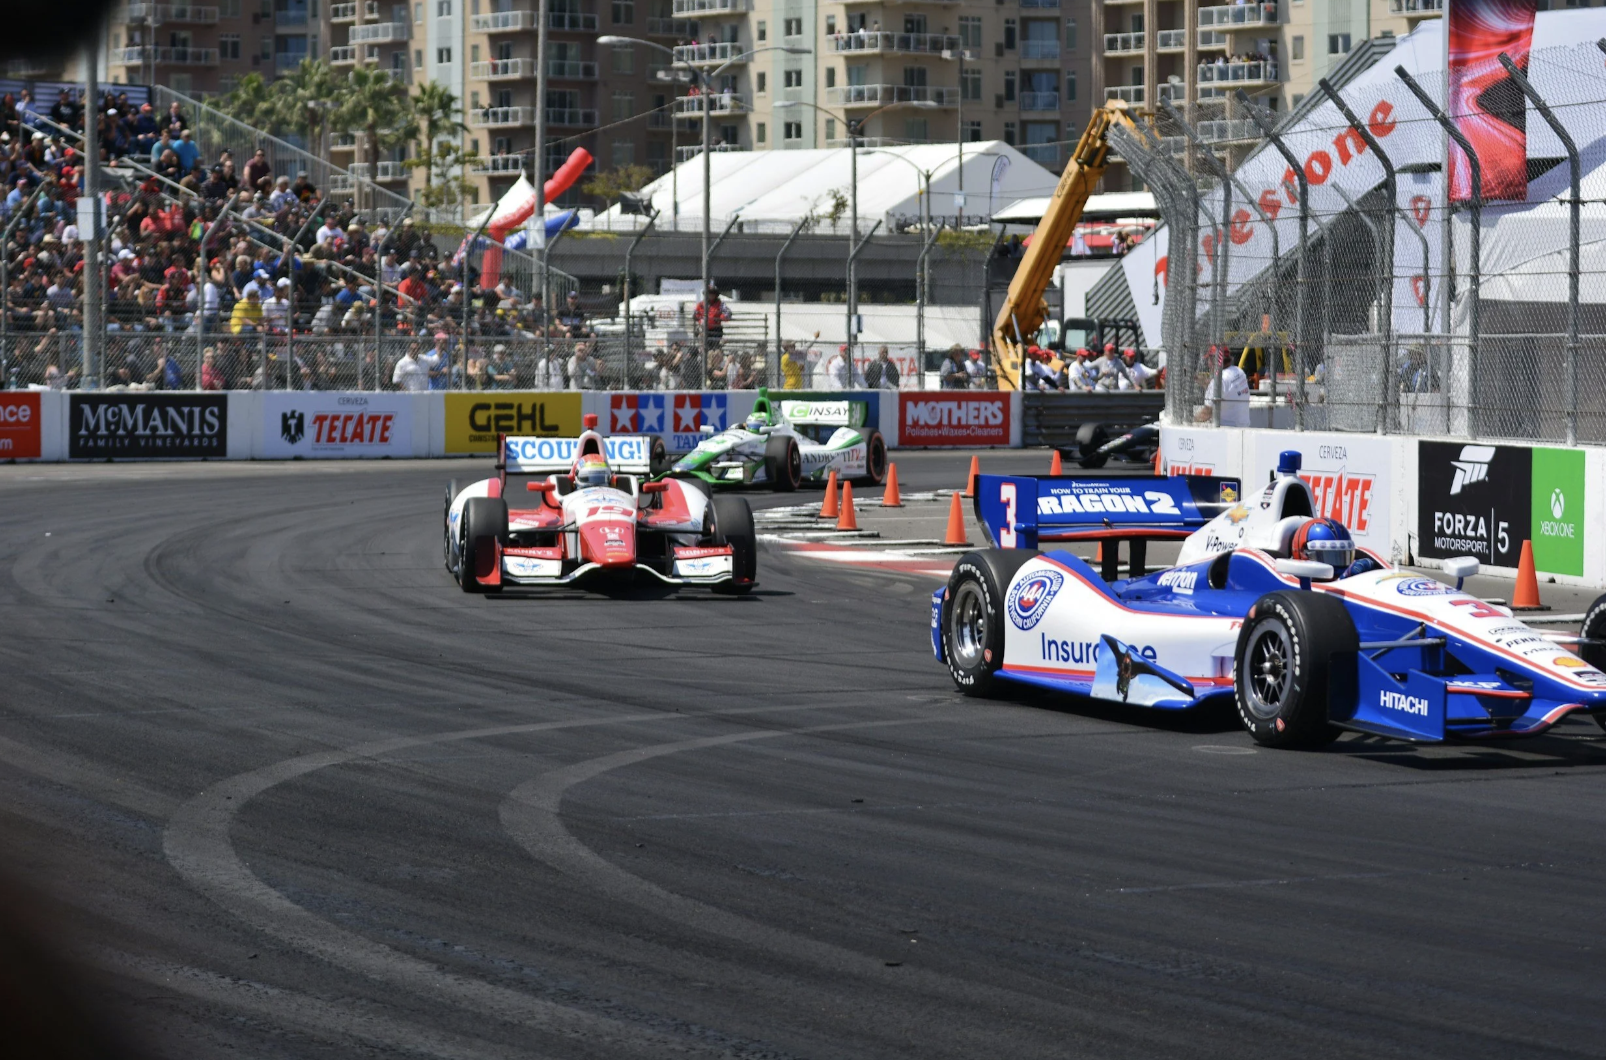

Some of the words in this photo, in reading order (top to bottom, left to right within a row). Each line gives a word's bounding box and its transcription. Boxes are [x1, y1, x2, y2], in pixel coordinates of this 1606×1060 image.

[338, 397, 369, 405] CERVEZA
[906, 401, 1003, 426] MOTHERS
[469, 402, 559, 432] GEHL
[79, 437, 130, 447] FAMILY
[139, 437, 219, 447] VINEYARDS
[506, 439, 642, 460] SCOUNG!
[1319, 445, 1347, 460] CERVEZA
[1000, 482, 1017, 549] 3
[1037, 494, 1150, 515] RAGON
[1144, 491, 1182, 515] 2
[1434, 511, 1487, 538] FORZA
[1497, 521, 1509, 553] 5
[1020, 584, 1044, 602] AAA
[1157, 568, 1198, 595] verizon
[1381, 690, 1428, 717] HITACHI
